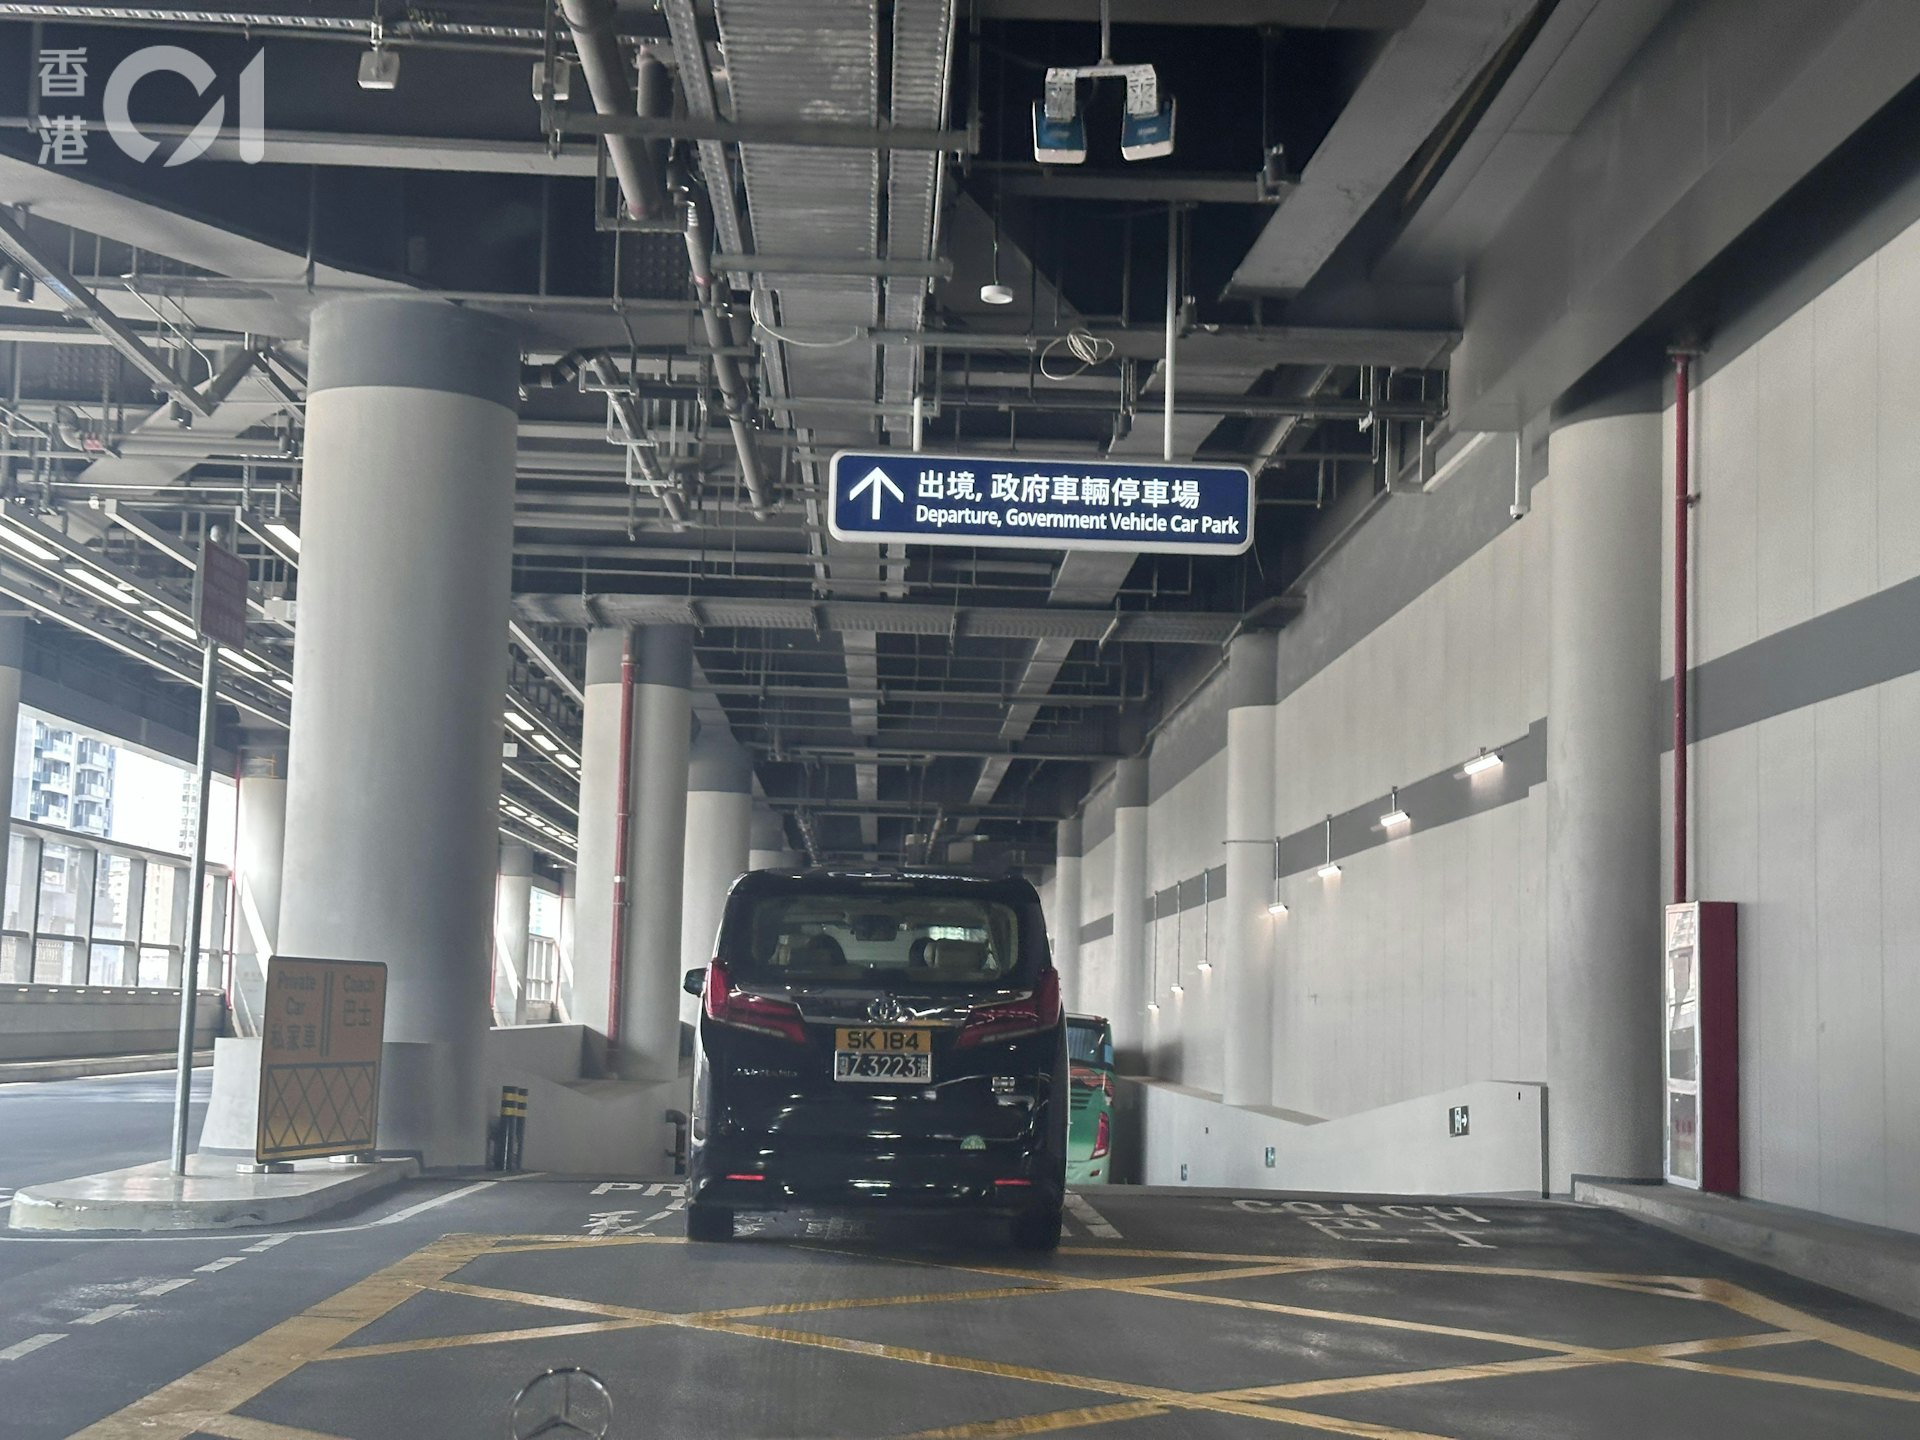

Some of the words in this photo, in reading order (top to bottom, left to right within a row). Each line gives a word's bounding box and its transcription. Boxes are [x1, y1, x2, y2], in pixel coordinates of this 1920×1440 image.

[916, 504, 1002, 527] Departure,
[1006, 508, 1107, 530] Government
[1109, 512, 1167, 531] Vehicle
[1170, 515, 1199, 533] Car
[1201, 516, 1239, 534] Park
[276, 971, 316, 991] Private
[343, 974, 375, 993] Coach
[286, 996, 305, 1015] Car
[344, 999, 371, 1027] 巴士
[848, 1031, 876, 1049] SK
[883, 1032, 919, 1050] 184
[1232, 1199, 1491, 1223] COACH
[1300, 1215, 1499, 1249] 巴士
